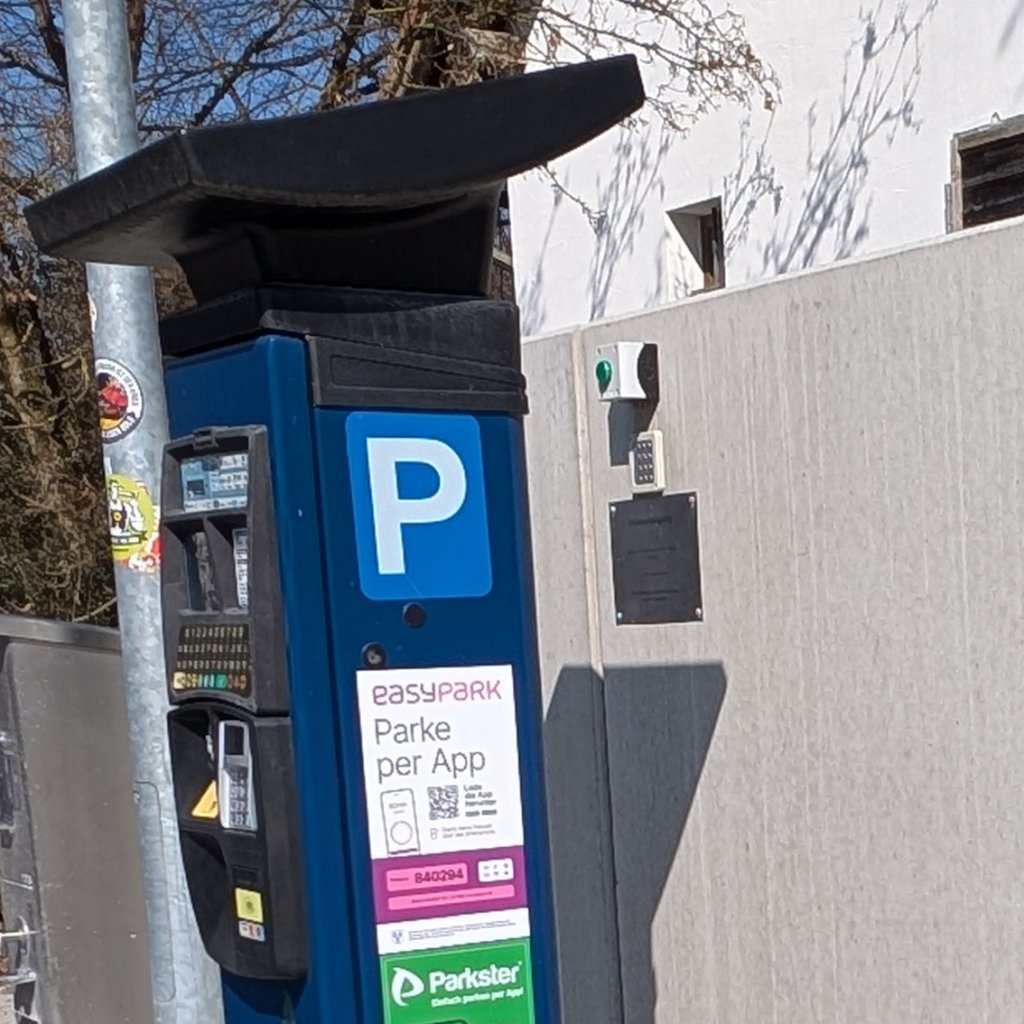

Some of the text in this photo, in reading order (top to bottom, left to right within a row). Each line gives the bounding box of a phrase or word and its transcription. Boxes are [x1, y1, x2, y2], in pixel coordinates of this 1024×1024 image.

[366, 437, 467, 574] P
[374, 716, 451, 745] Parke
[376, 748, 486, 784] per App
[414, 868, 464, 884] 840294
[429, 964, 520, 994] Parkster
